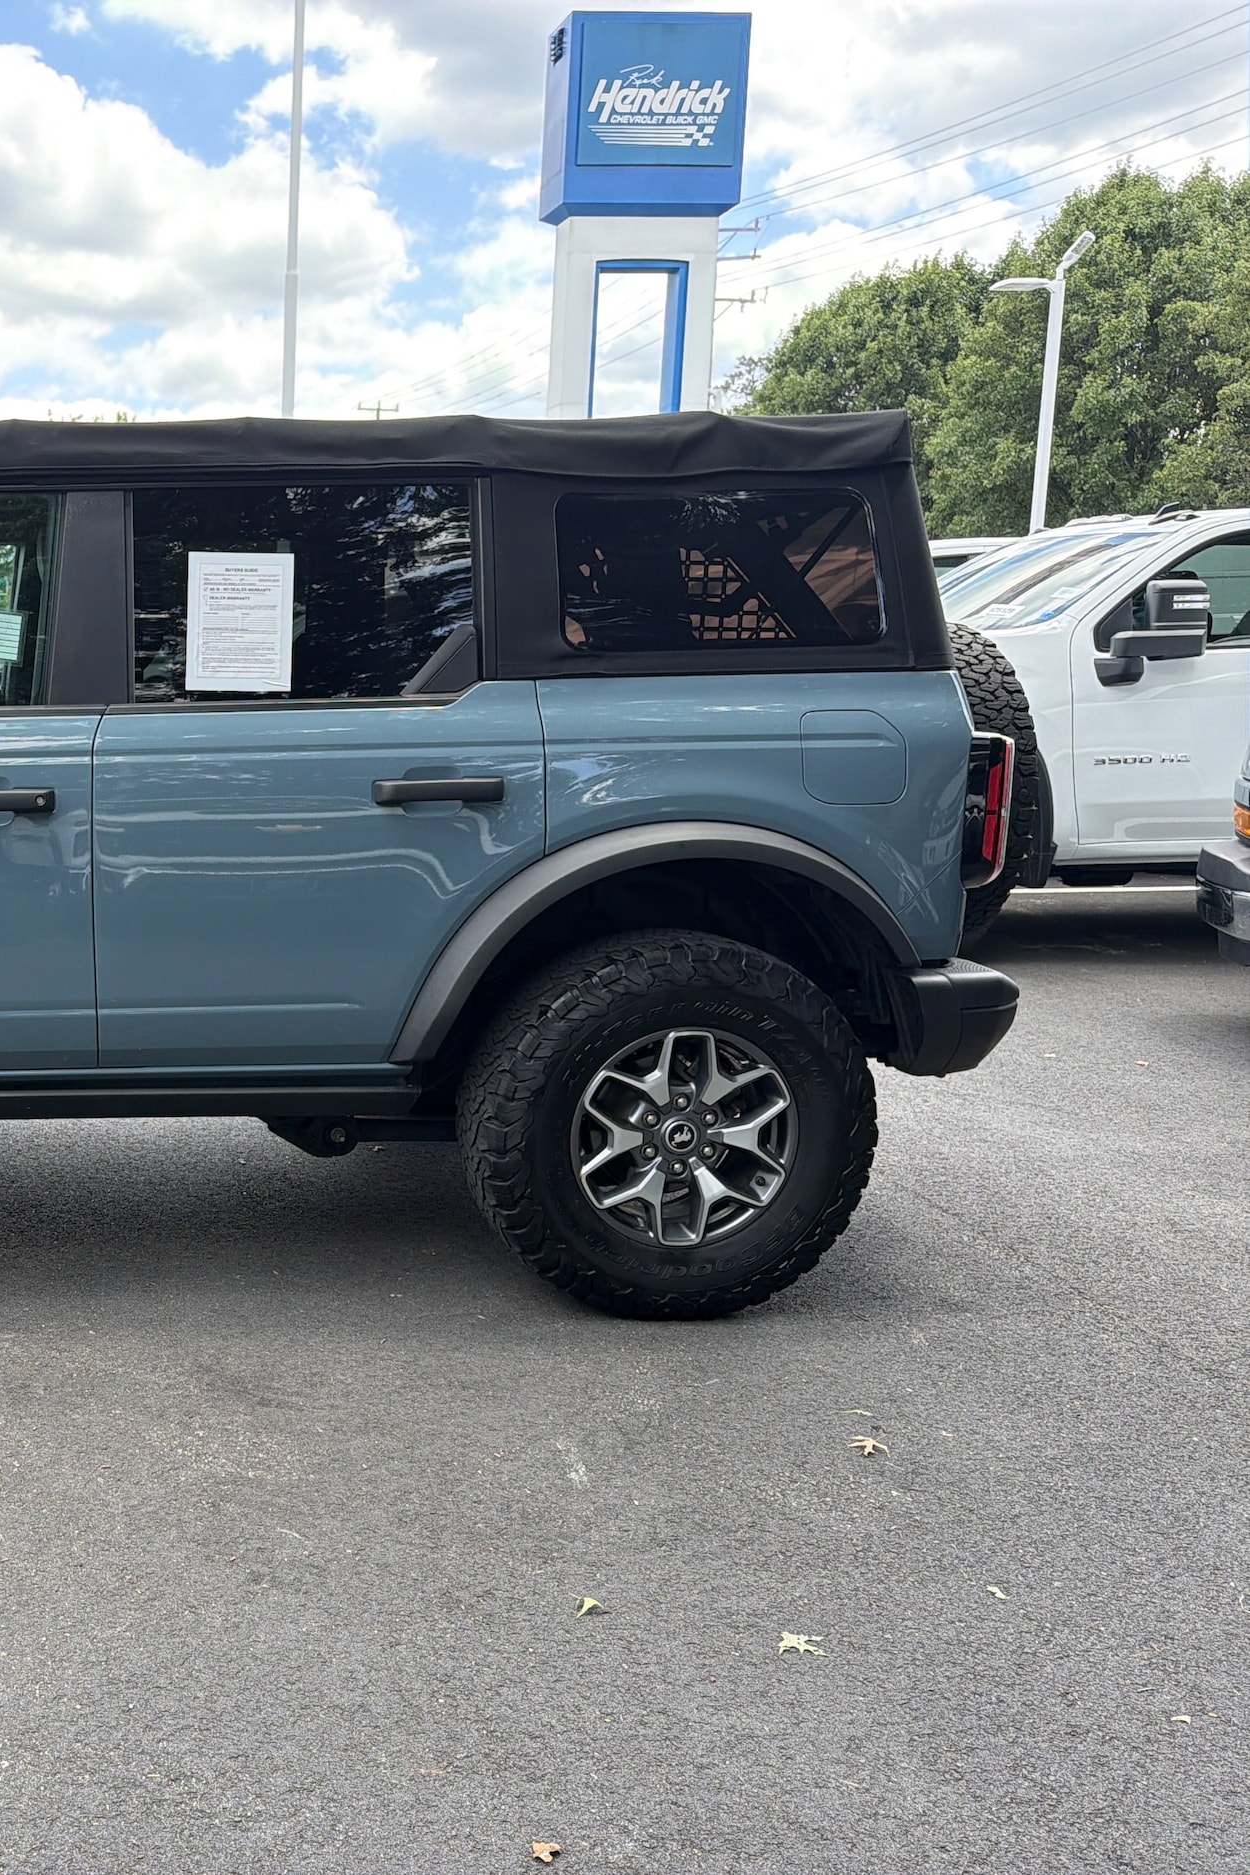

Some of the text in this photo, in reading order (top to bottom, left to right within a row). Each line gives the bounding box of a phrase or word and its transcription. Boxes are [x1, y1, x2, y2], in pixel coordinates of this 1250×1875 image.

[587, 78, 731, 123] Hendrick
[610, 115, 719, 124] CHEVROLET BUICK GMC
[1093, 753, 1191, 766] 3500 HD
